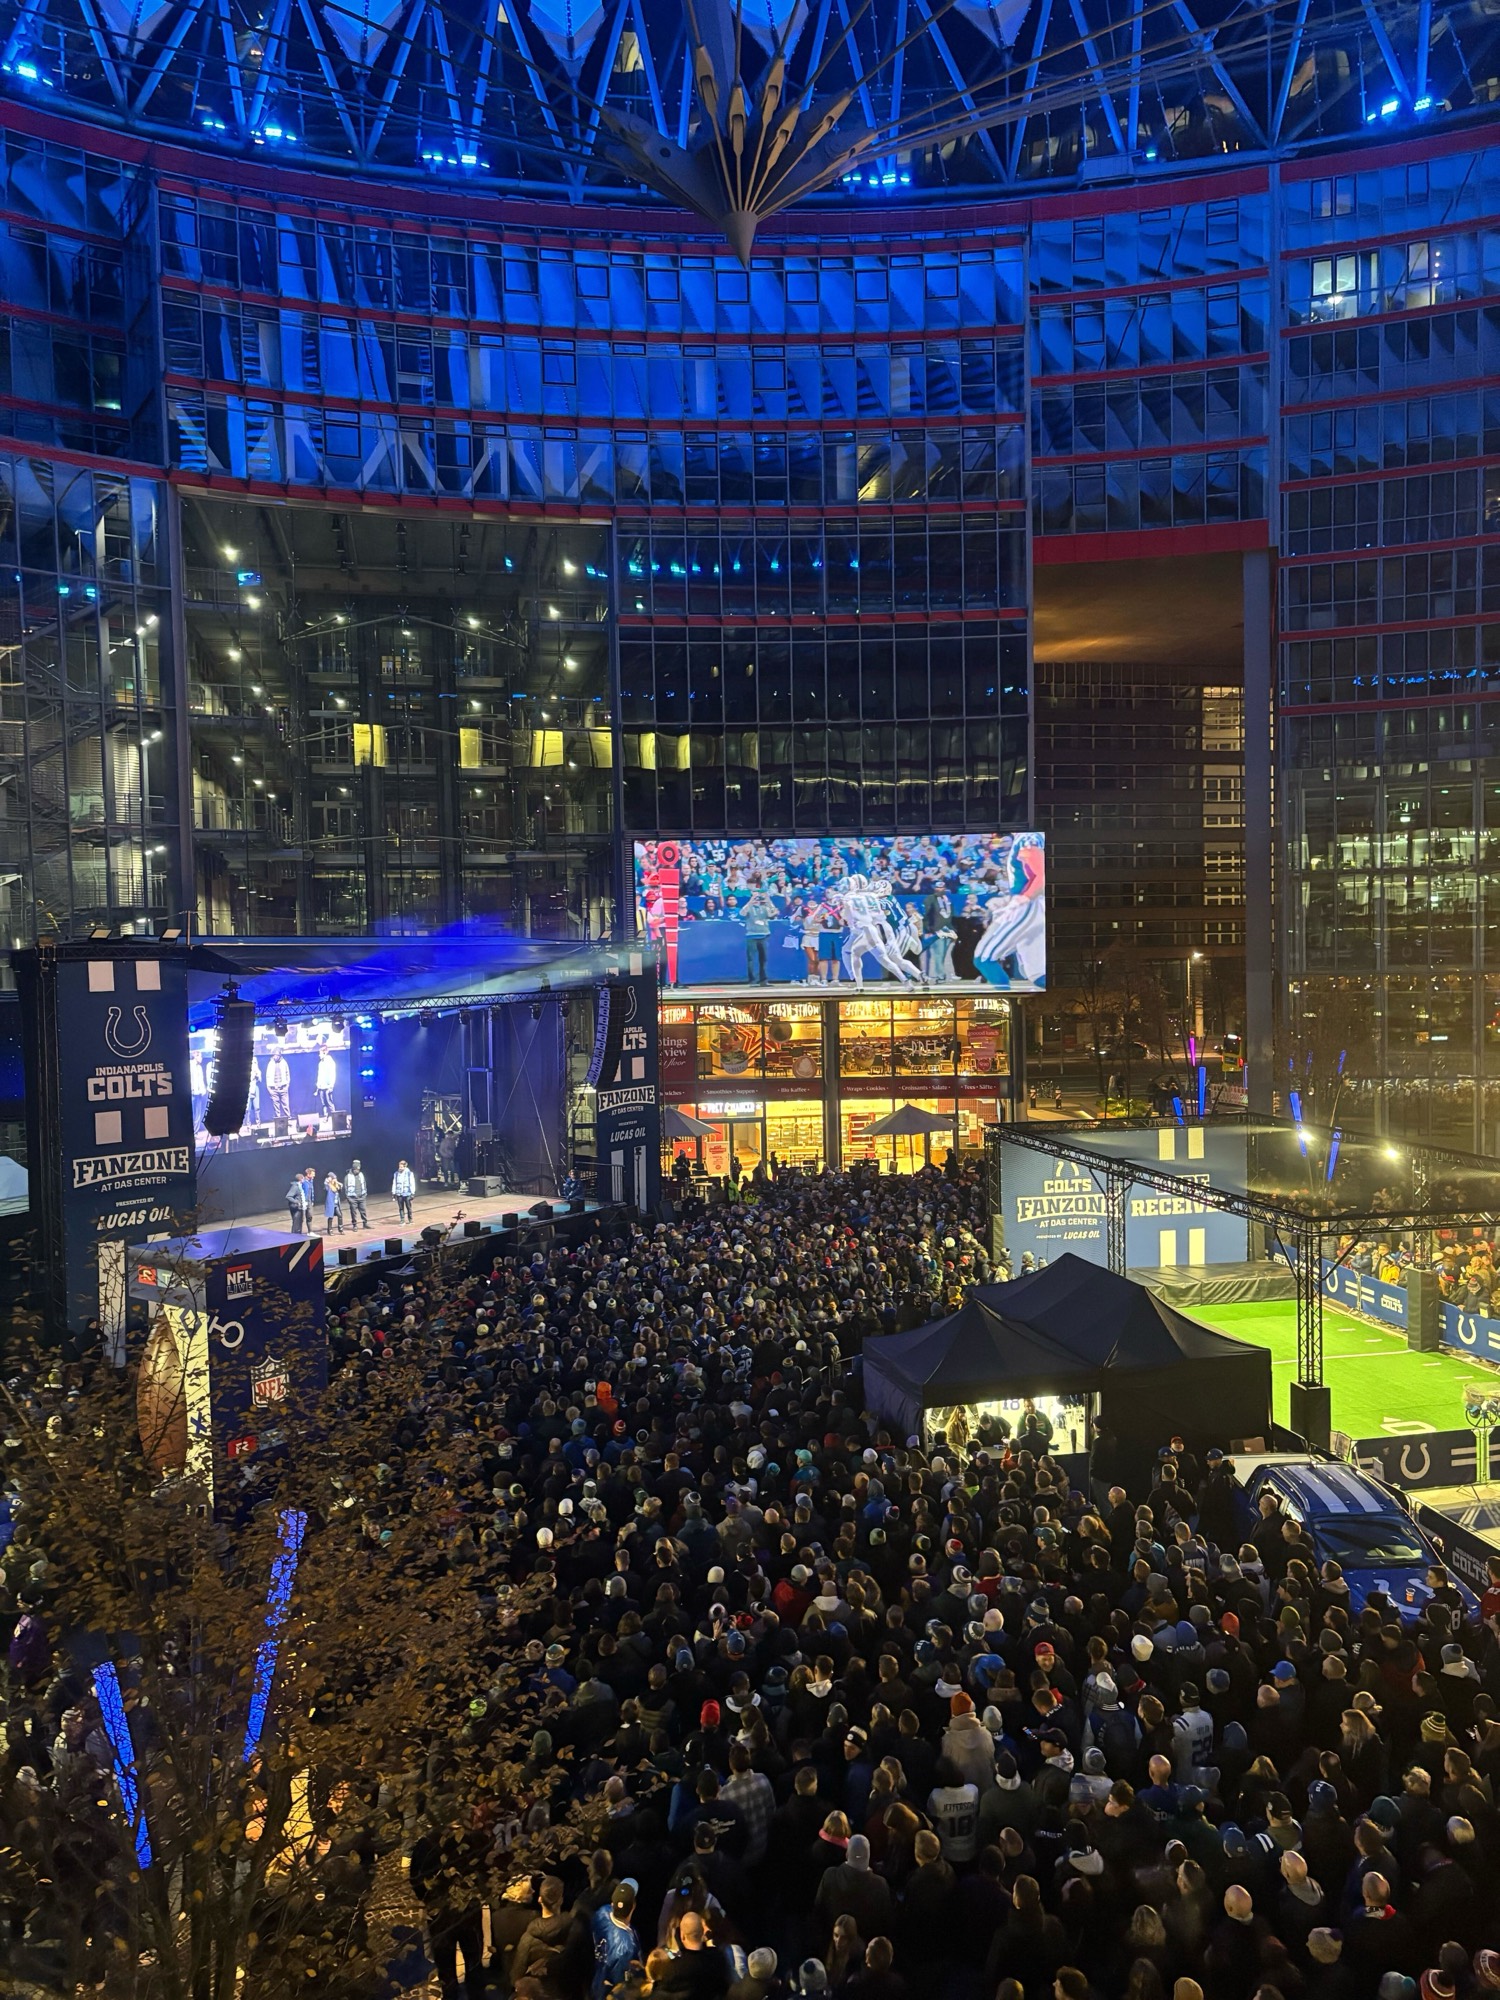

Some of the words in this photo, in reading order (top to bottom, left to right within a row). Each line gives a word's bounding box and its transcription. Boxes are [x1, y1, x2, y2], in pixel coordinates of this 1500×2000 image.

[622, 1033, 647, 1050] LTS
[664, 1047, 688, 1057] view
[95, 1063, 164, 1077] INDIANAPOLIS
[87, 1072, 173, 1102] COLTS
[599, 1087, 655, 1110] FANZONE
[610, 1129, 634, 1143] LUCAS
[635, 1127, 646, 1138] OIL
[72, 1147, 189, 1188] FANZONE
[101, 1183, 113, 1193] AT
[114, 1179, 133, 1190] DAS
[134, 1176, 167, 1186] CENTER
[1043, 1178, 1092, 1194] COLTS
[96, 1210, 147, 1231] LUCAS
[149, 1206, 171, 1223] OIL
[1039, 1220, 1049, 1229] AT
[1050, 1219, 1067, 1227] DAS
[1067, 1218, 1098, 1226] CENTER
[1063, 1231, 1087, 1240] LUCAS
[1088, 1230, 1101, 1239] OIL
[226, 1269, 253, 1286] NFL
[226, 1281, 253, 1294] LIVE
[1380, 1297, 1403, 1314] COLTS
[256, 1377, 286, 1397] NFL
[1452, 1550, 1489, 1587] COLTS
